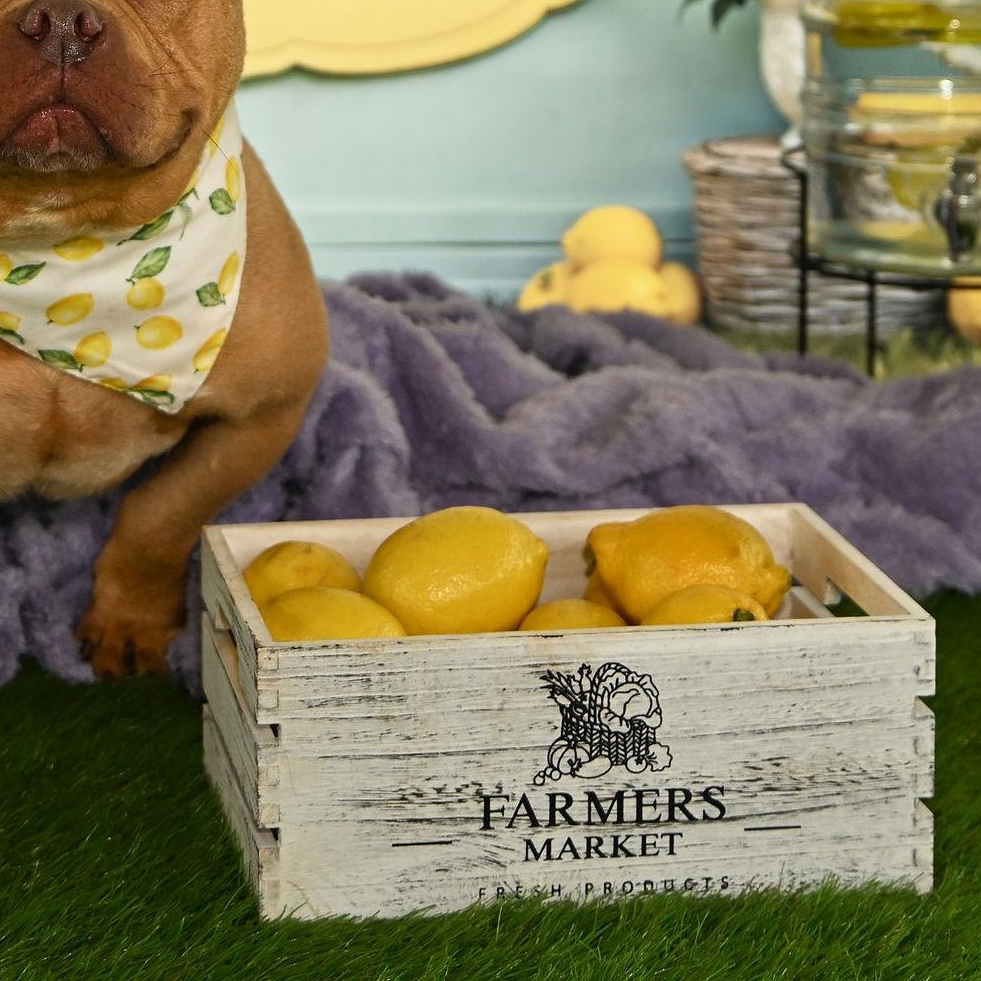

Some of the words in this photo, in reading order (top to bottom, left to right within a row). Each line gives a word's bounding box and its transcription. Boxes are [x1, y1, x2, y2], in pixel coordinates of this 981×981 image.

[479, 785, 727, 831] FARMERS
[523, 832, 684, 862] MARKET
[478, 884, 562, 900] FRESH
[584, 875, 730, 896] PRODUCTS
